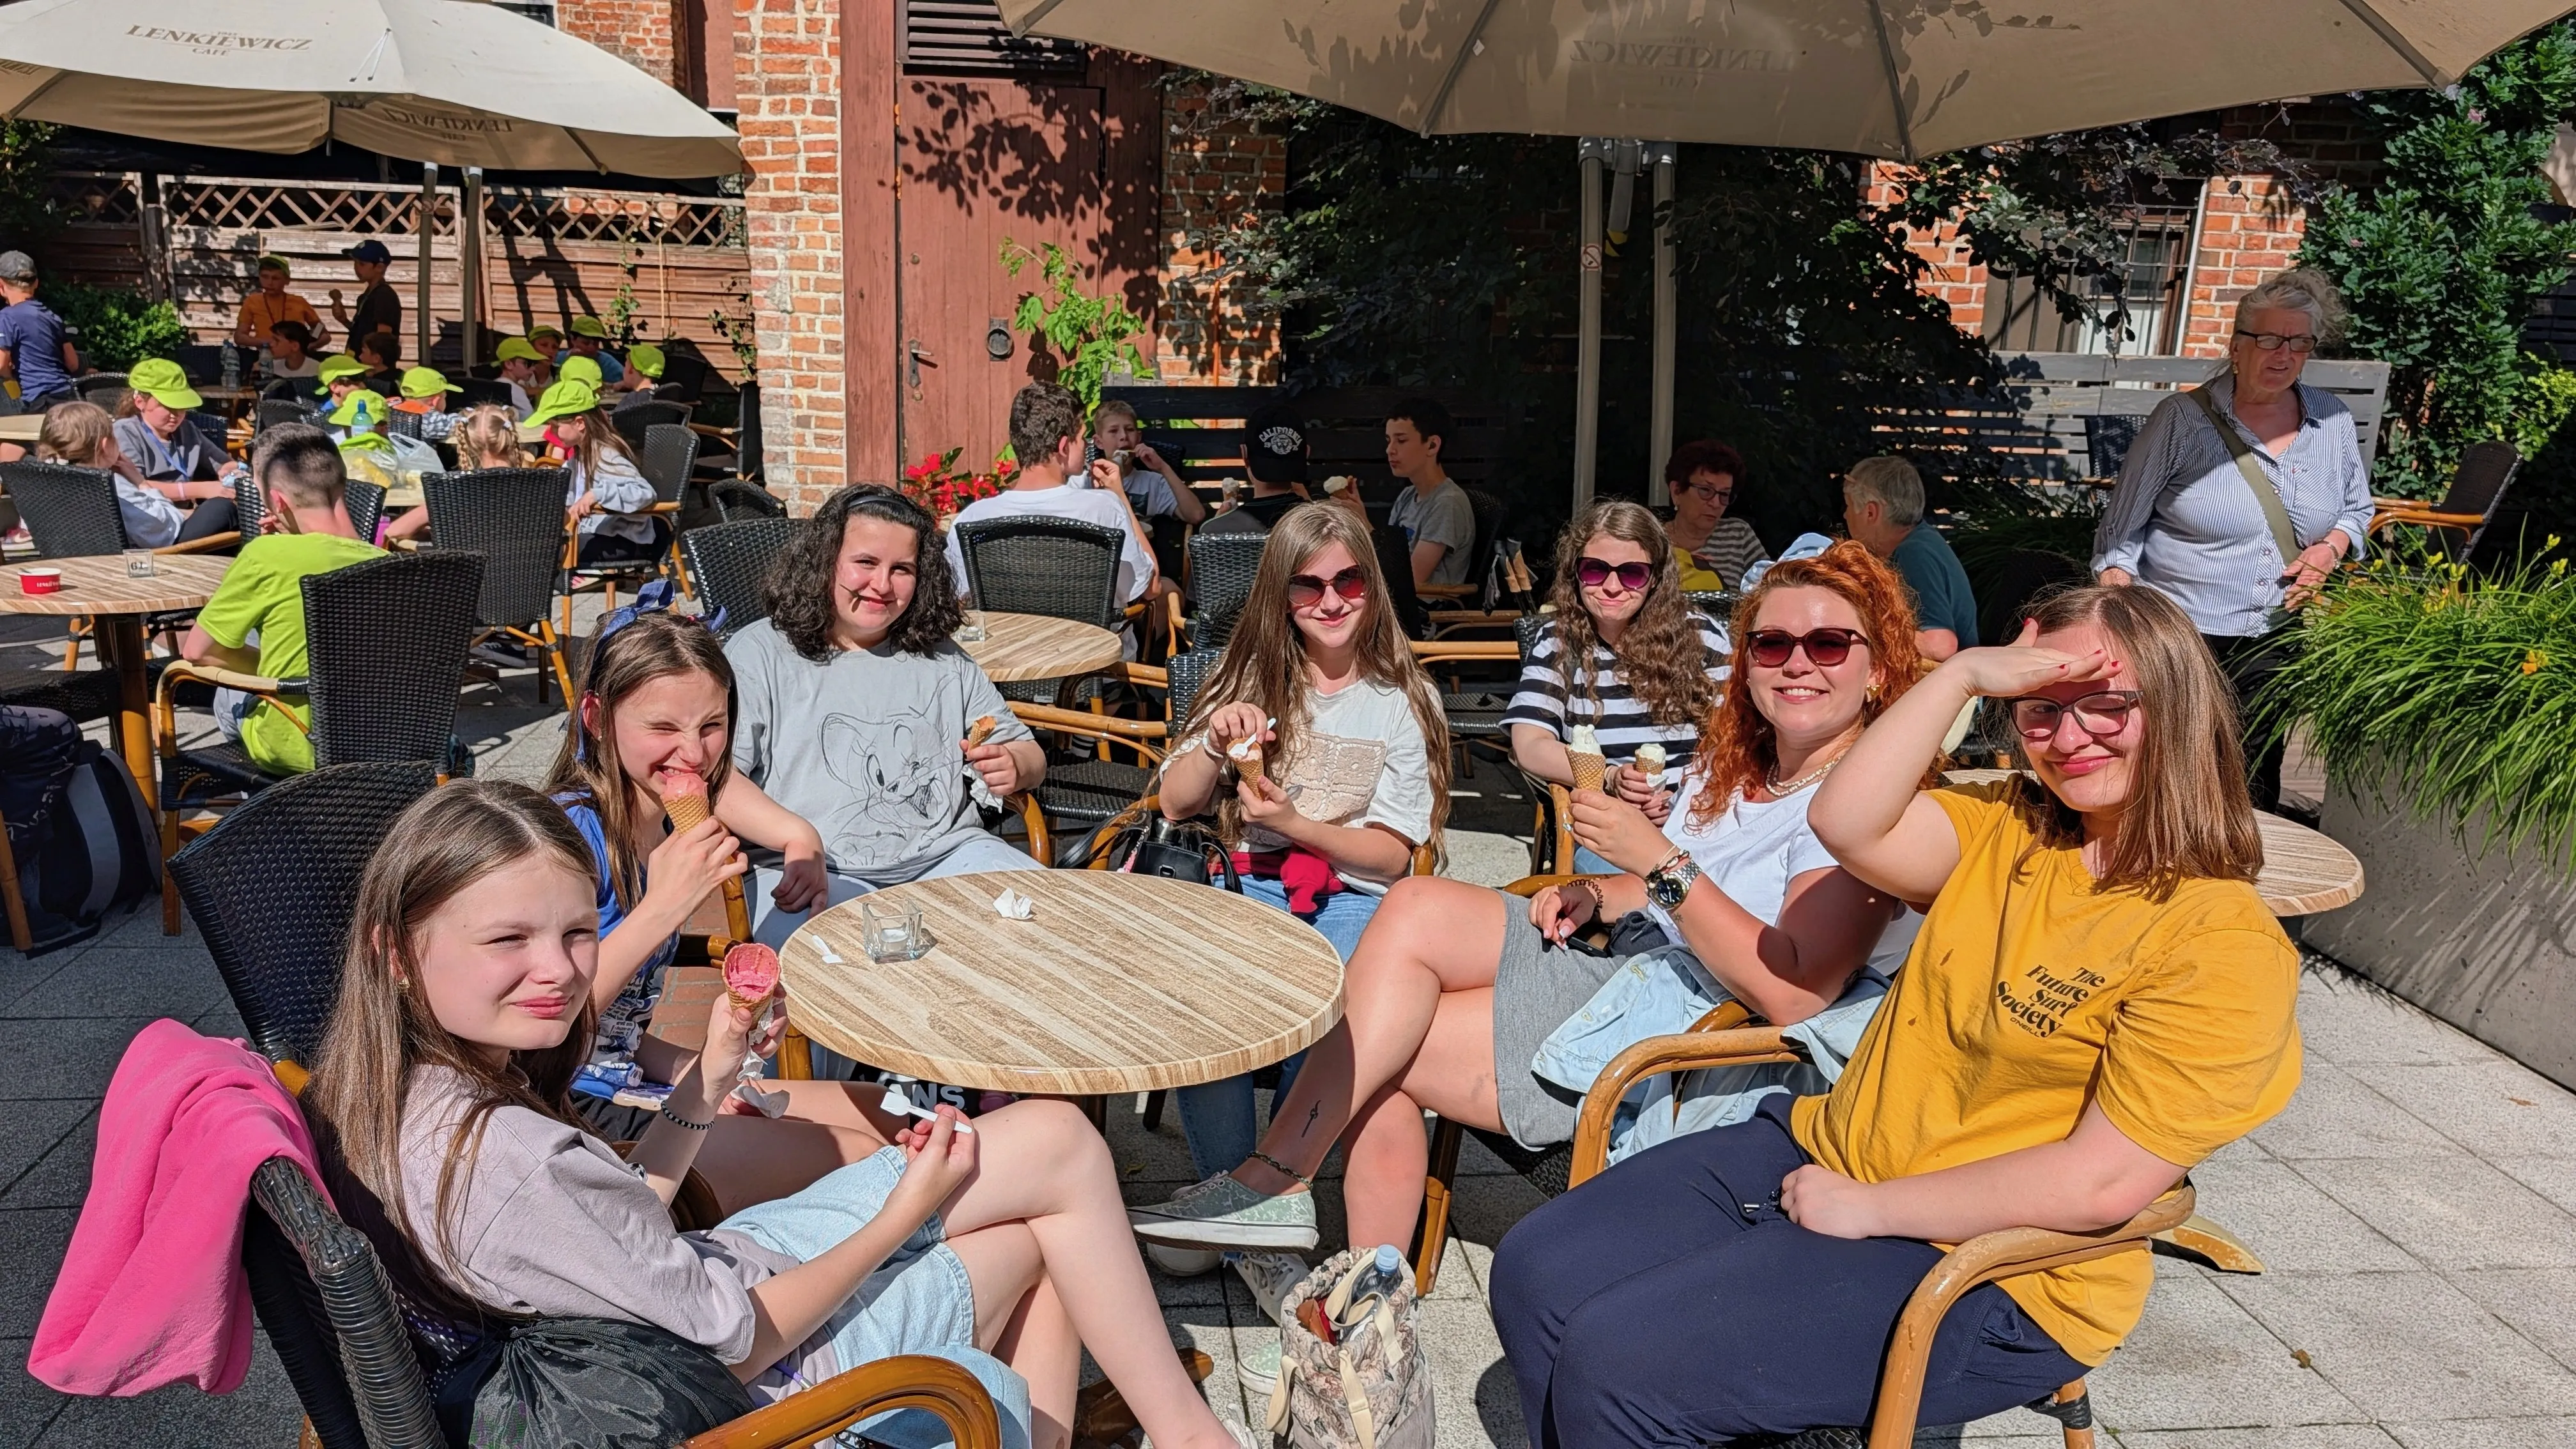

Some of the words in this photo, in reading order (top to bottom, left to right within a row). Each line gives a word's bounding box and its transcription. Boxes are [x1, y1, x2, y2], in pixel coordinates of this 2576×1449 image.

[126, 25, 312, 50] LENKIEWICZ
[1259, 426, 1303, 447] CALIFORNIA
[2024, 964, 2089, 1002] Future
[2069, 967, 2106, 988] The
[1995, 981, 2064, 1038] Society
[2028, 989, 2078, 1020] Surf
